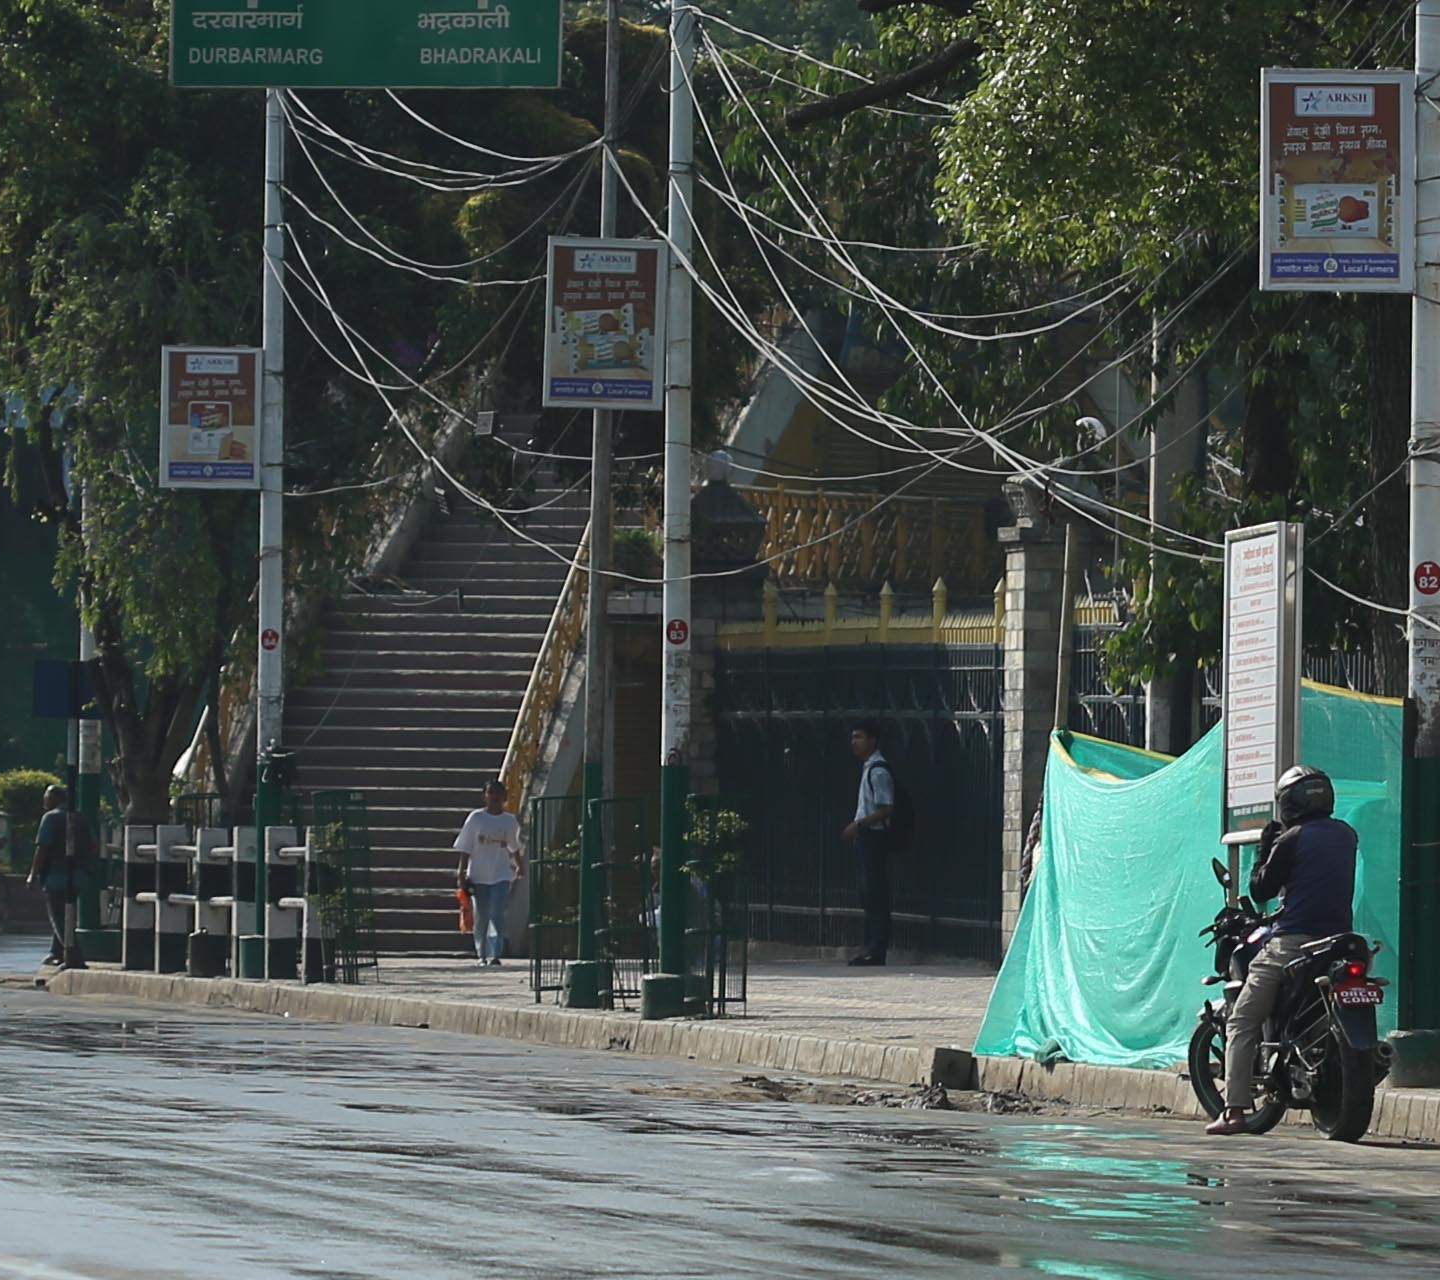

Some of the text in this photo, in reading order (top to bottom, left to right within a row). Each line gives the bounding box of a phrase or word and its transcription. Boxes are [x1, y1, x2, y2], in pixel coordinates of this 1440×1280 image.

[191, 3, 304, 31] दरबारमार्ग
[417, 4, 511, 35] भद्रकाली
[188, 47, 324, 66] DURBARMARG
[419, 47, 542, 65] BHADRAKALI
[1326, 93, 1367, 103] ARKSH
[1423, 564, 1433, 575] T
[1418, 576, 1439, 589] 82
